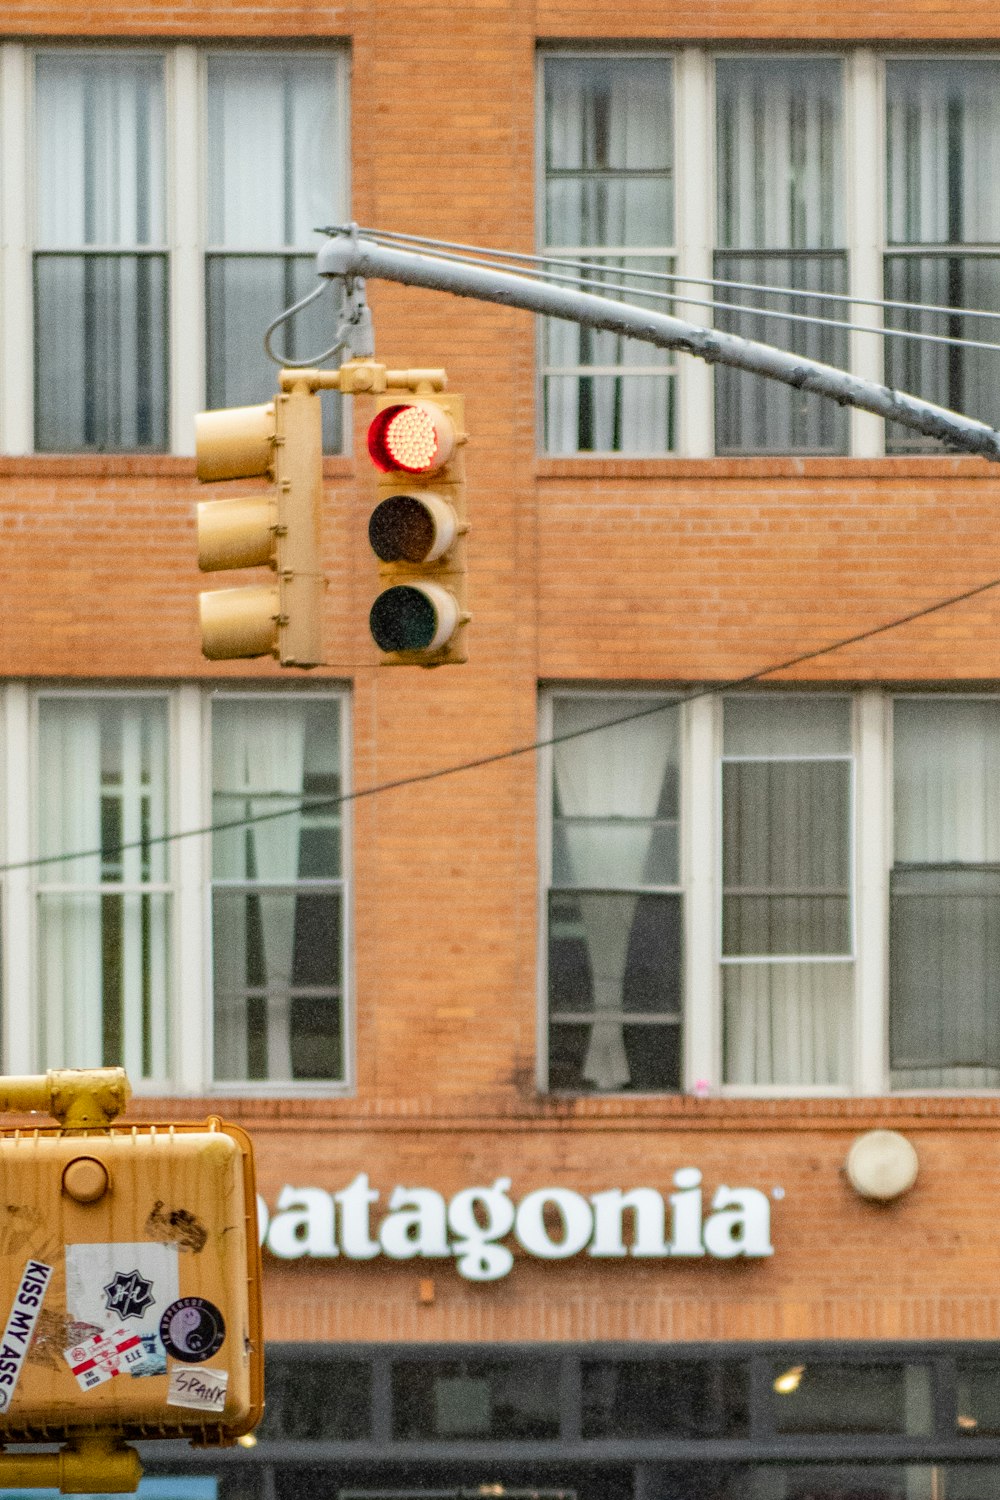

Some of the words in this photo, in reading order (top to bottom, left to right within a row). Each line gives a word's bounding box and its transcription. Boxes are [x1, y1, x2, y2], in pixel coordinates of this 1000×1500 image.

[257, 1166, 775, 1282] atagonia
[18, 1261, 51, 1309] KISS
[8, 1310, 33, 1345] MY
[0, 1343, 22, 1387] ASS
